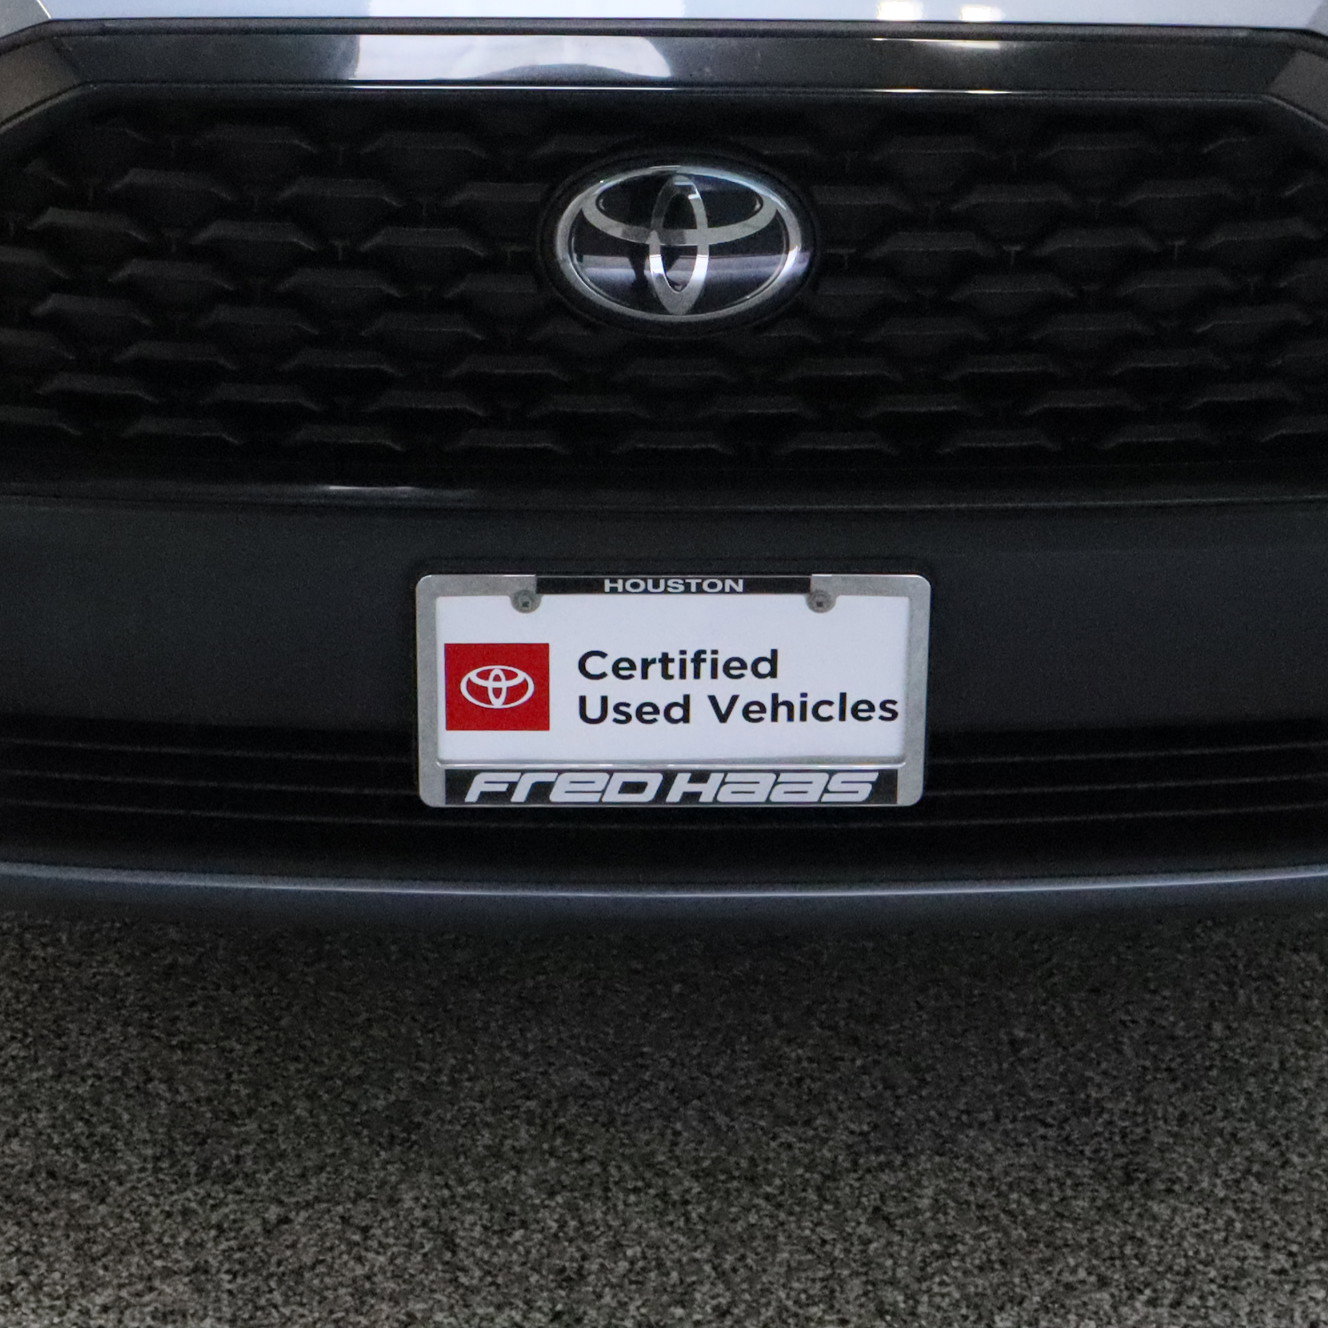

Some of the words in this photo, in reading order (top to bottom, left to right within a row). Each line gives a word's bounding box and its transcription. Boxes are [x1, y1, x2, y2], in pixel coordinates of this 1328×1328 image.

[604, 578, 744, 593] HOUSTON
[577, 649, 779, 680] Certified
[578, 694, 691, 724] Used
[707, 692, 899, 723] Vehicles
